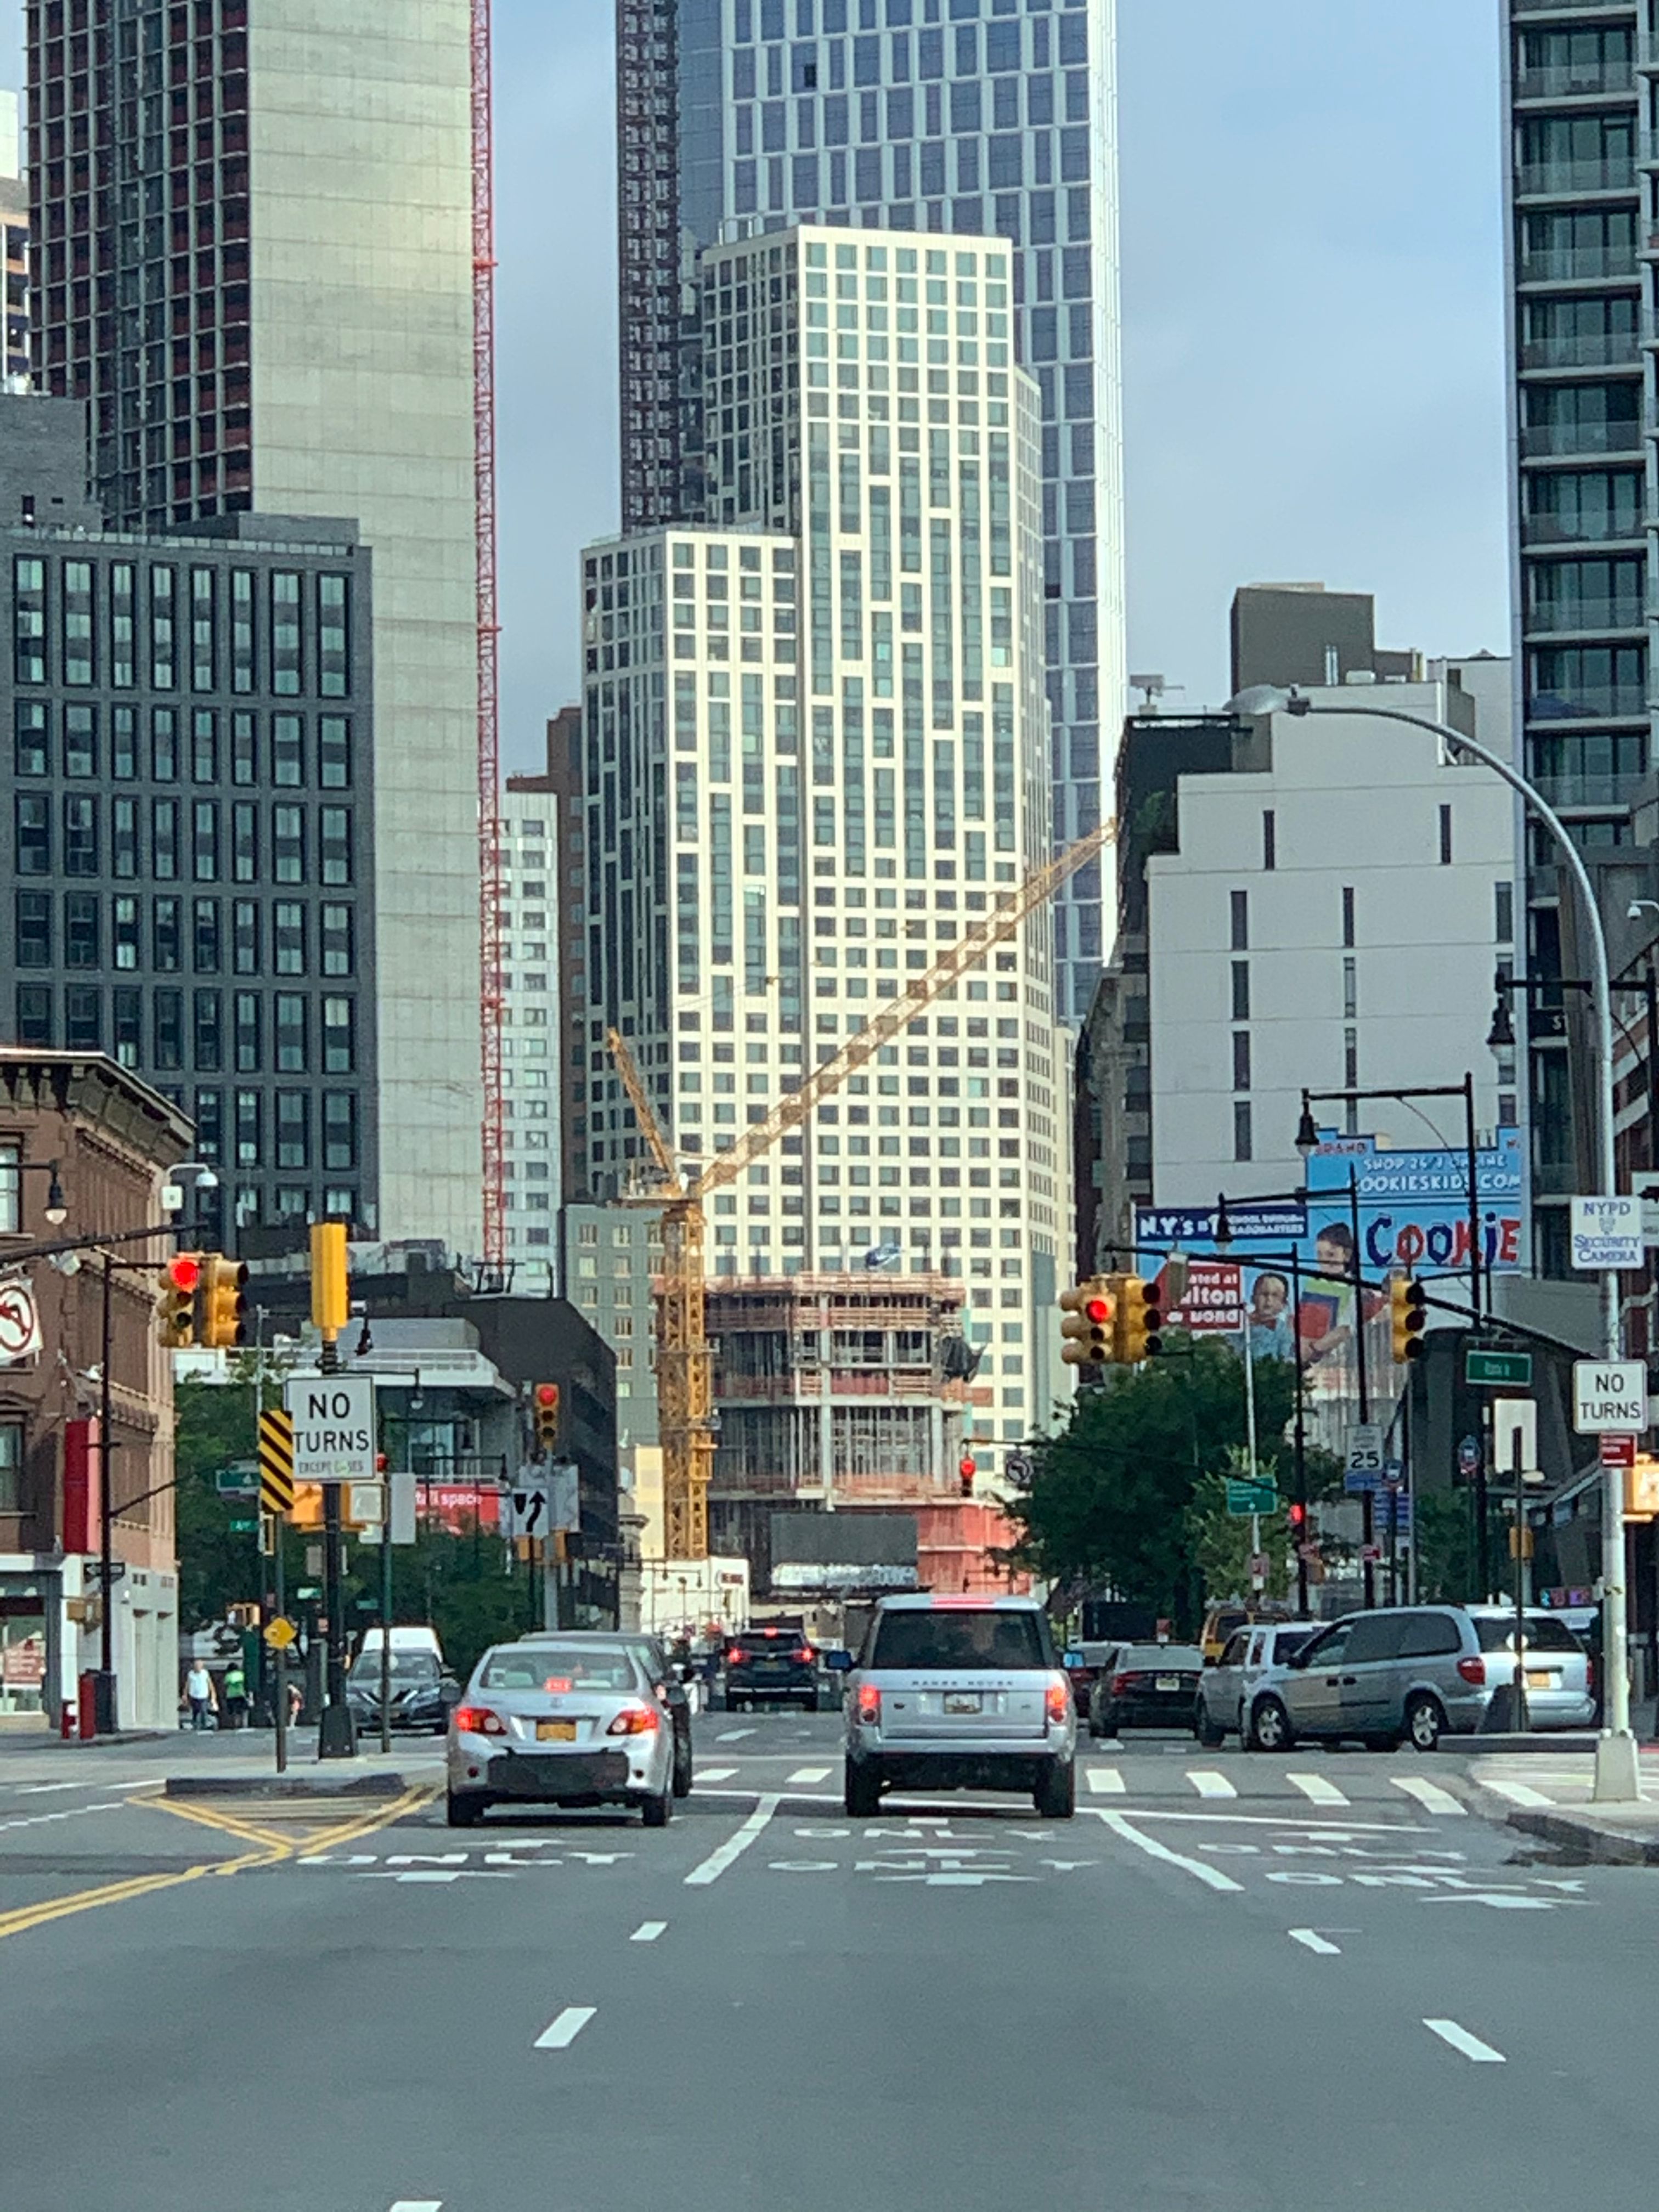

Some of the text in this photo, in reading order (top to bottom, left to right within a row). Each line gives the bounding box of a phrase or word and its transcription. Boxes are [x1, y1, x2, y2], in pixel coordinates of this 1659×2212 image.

[1363, 1158, 1404, 1171] SHOP
[1583, 1202, 1631, 1216] NYPD
[1574, 1234, 1640, 1248] SECURITY
[1578, 1248, 1638, 1262] CAMERA
[1595, 1374, 1624, 1392] NO
[308, 1392, 351, 1419] NO
[1580, 1401, 1641, 1420] TURNS
[293, 1430, 369, 1453] TURNS
[1351, 1451, 1379, 1468] 25
